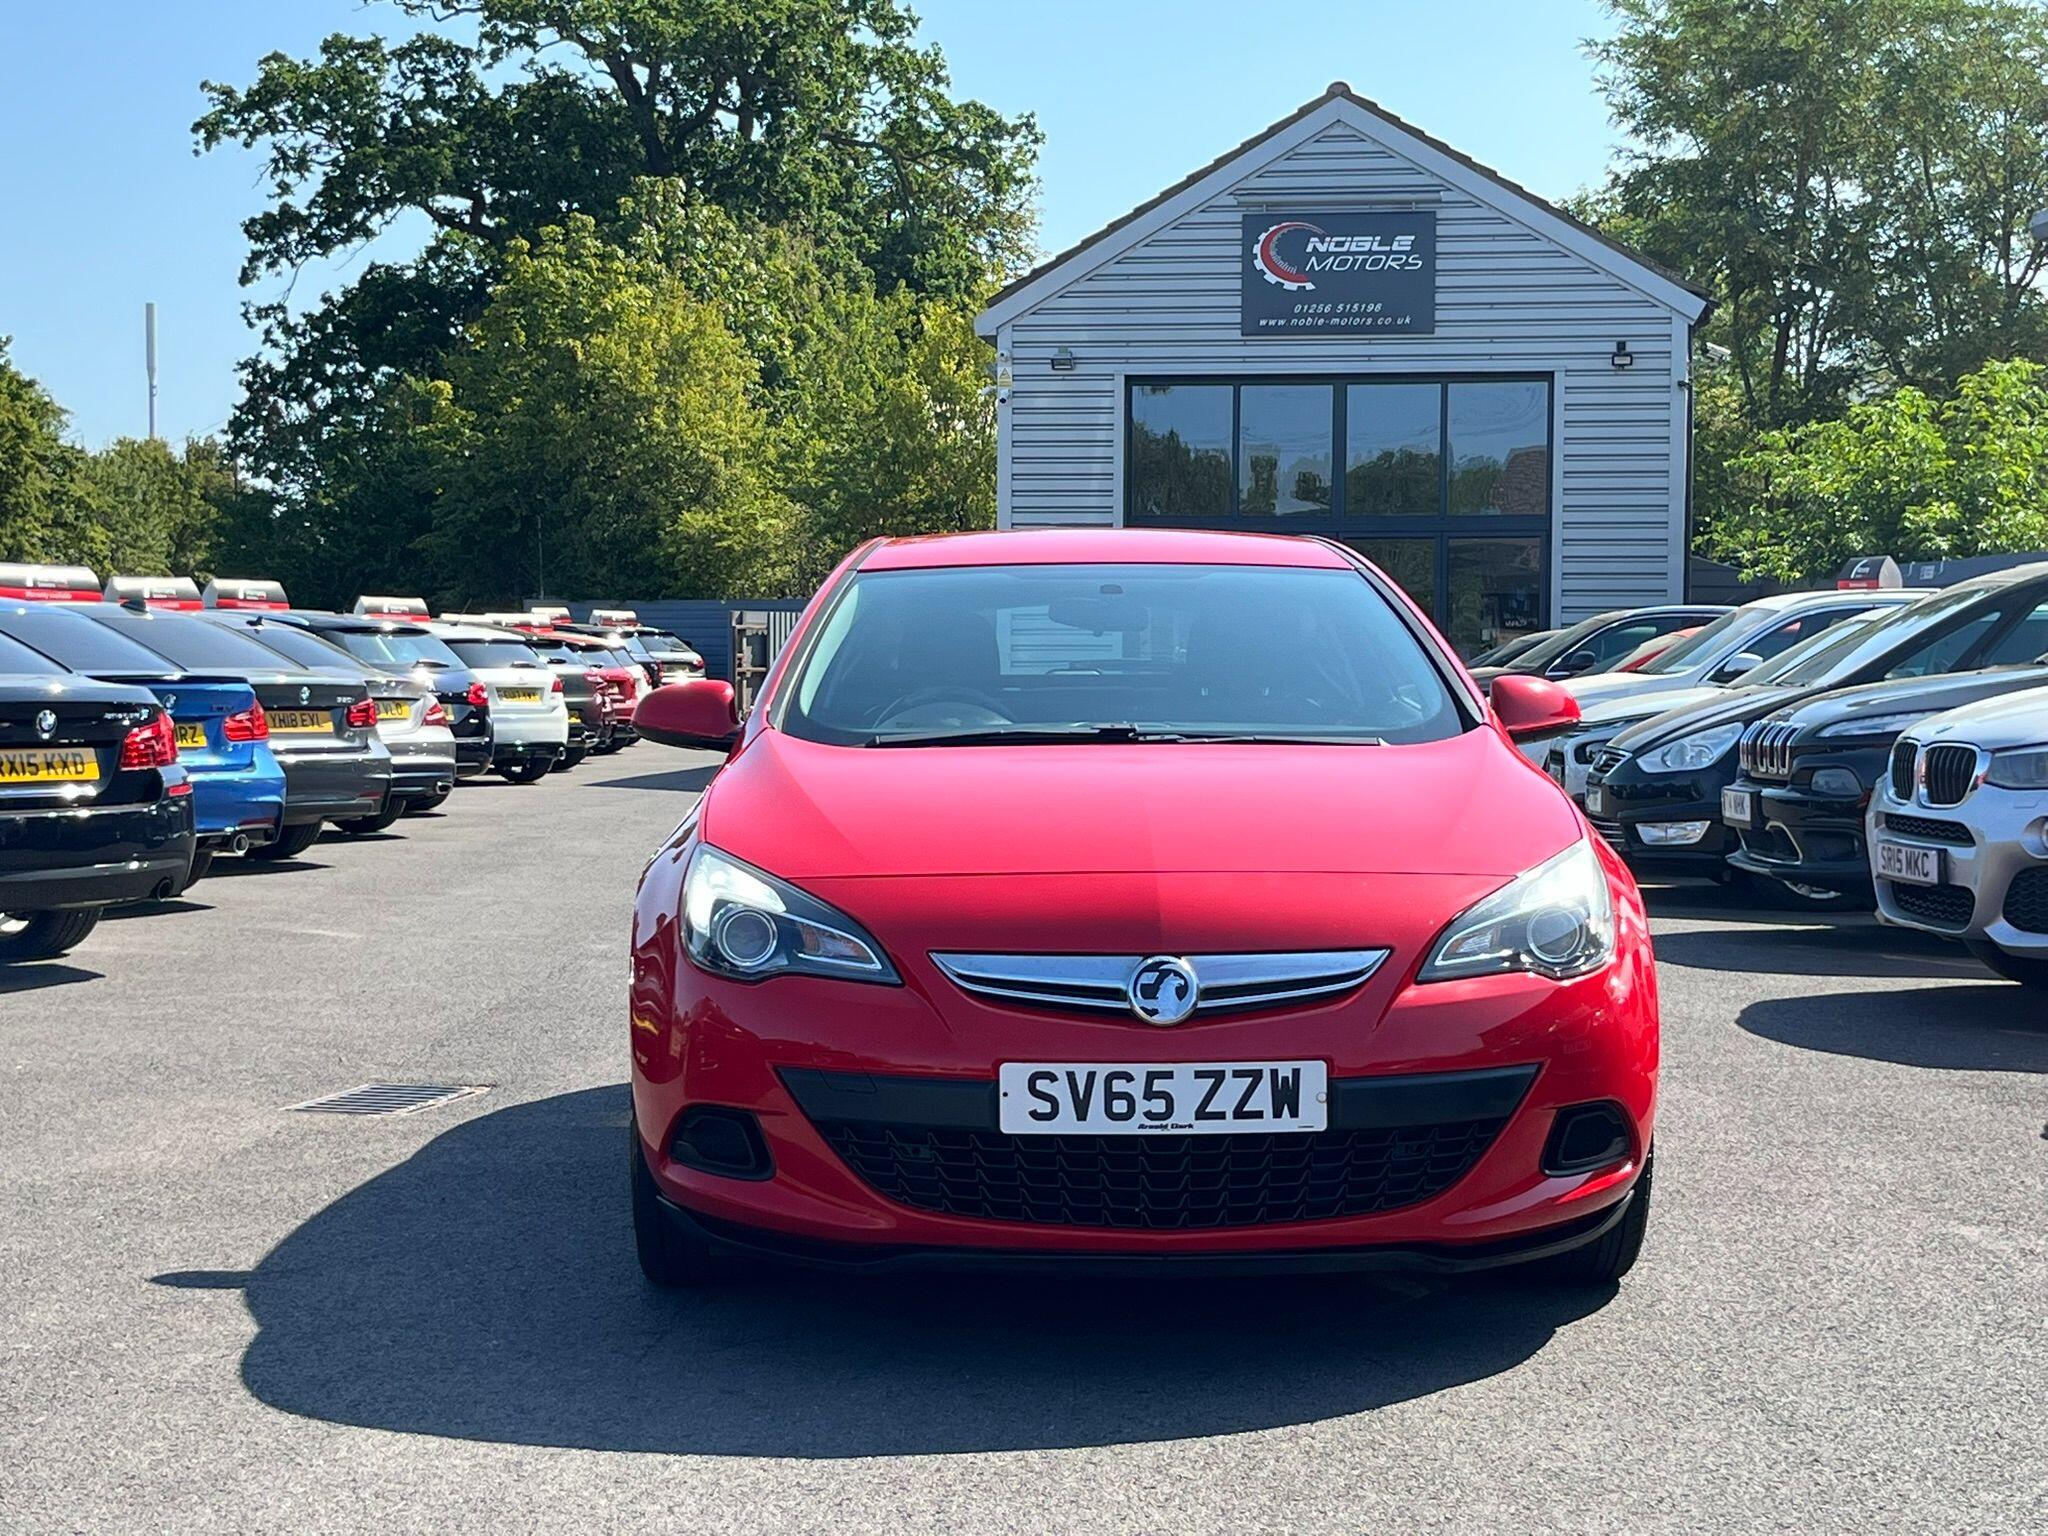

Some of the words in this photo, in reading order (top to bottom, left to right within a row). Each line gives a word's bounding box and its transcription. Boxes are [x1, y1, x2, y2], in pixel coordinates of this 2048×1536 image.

[1305, 236, 1415, 253] NOBLE
[1305, 255, 1423, 271] MOTORS
[1293, 303, 1332, 313] 01256
[1258, 314, 1411, 327] www.noble-motors.co.uk
[270, 711, 298, 729] YH18
[46, 751, 85, 775] KXD
[1881, 845, 1904, 874] SR15
[1026, 1070, 1174, 1122] SV65
[1193, 1067, 1301, 1121] ZZW
